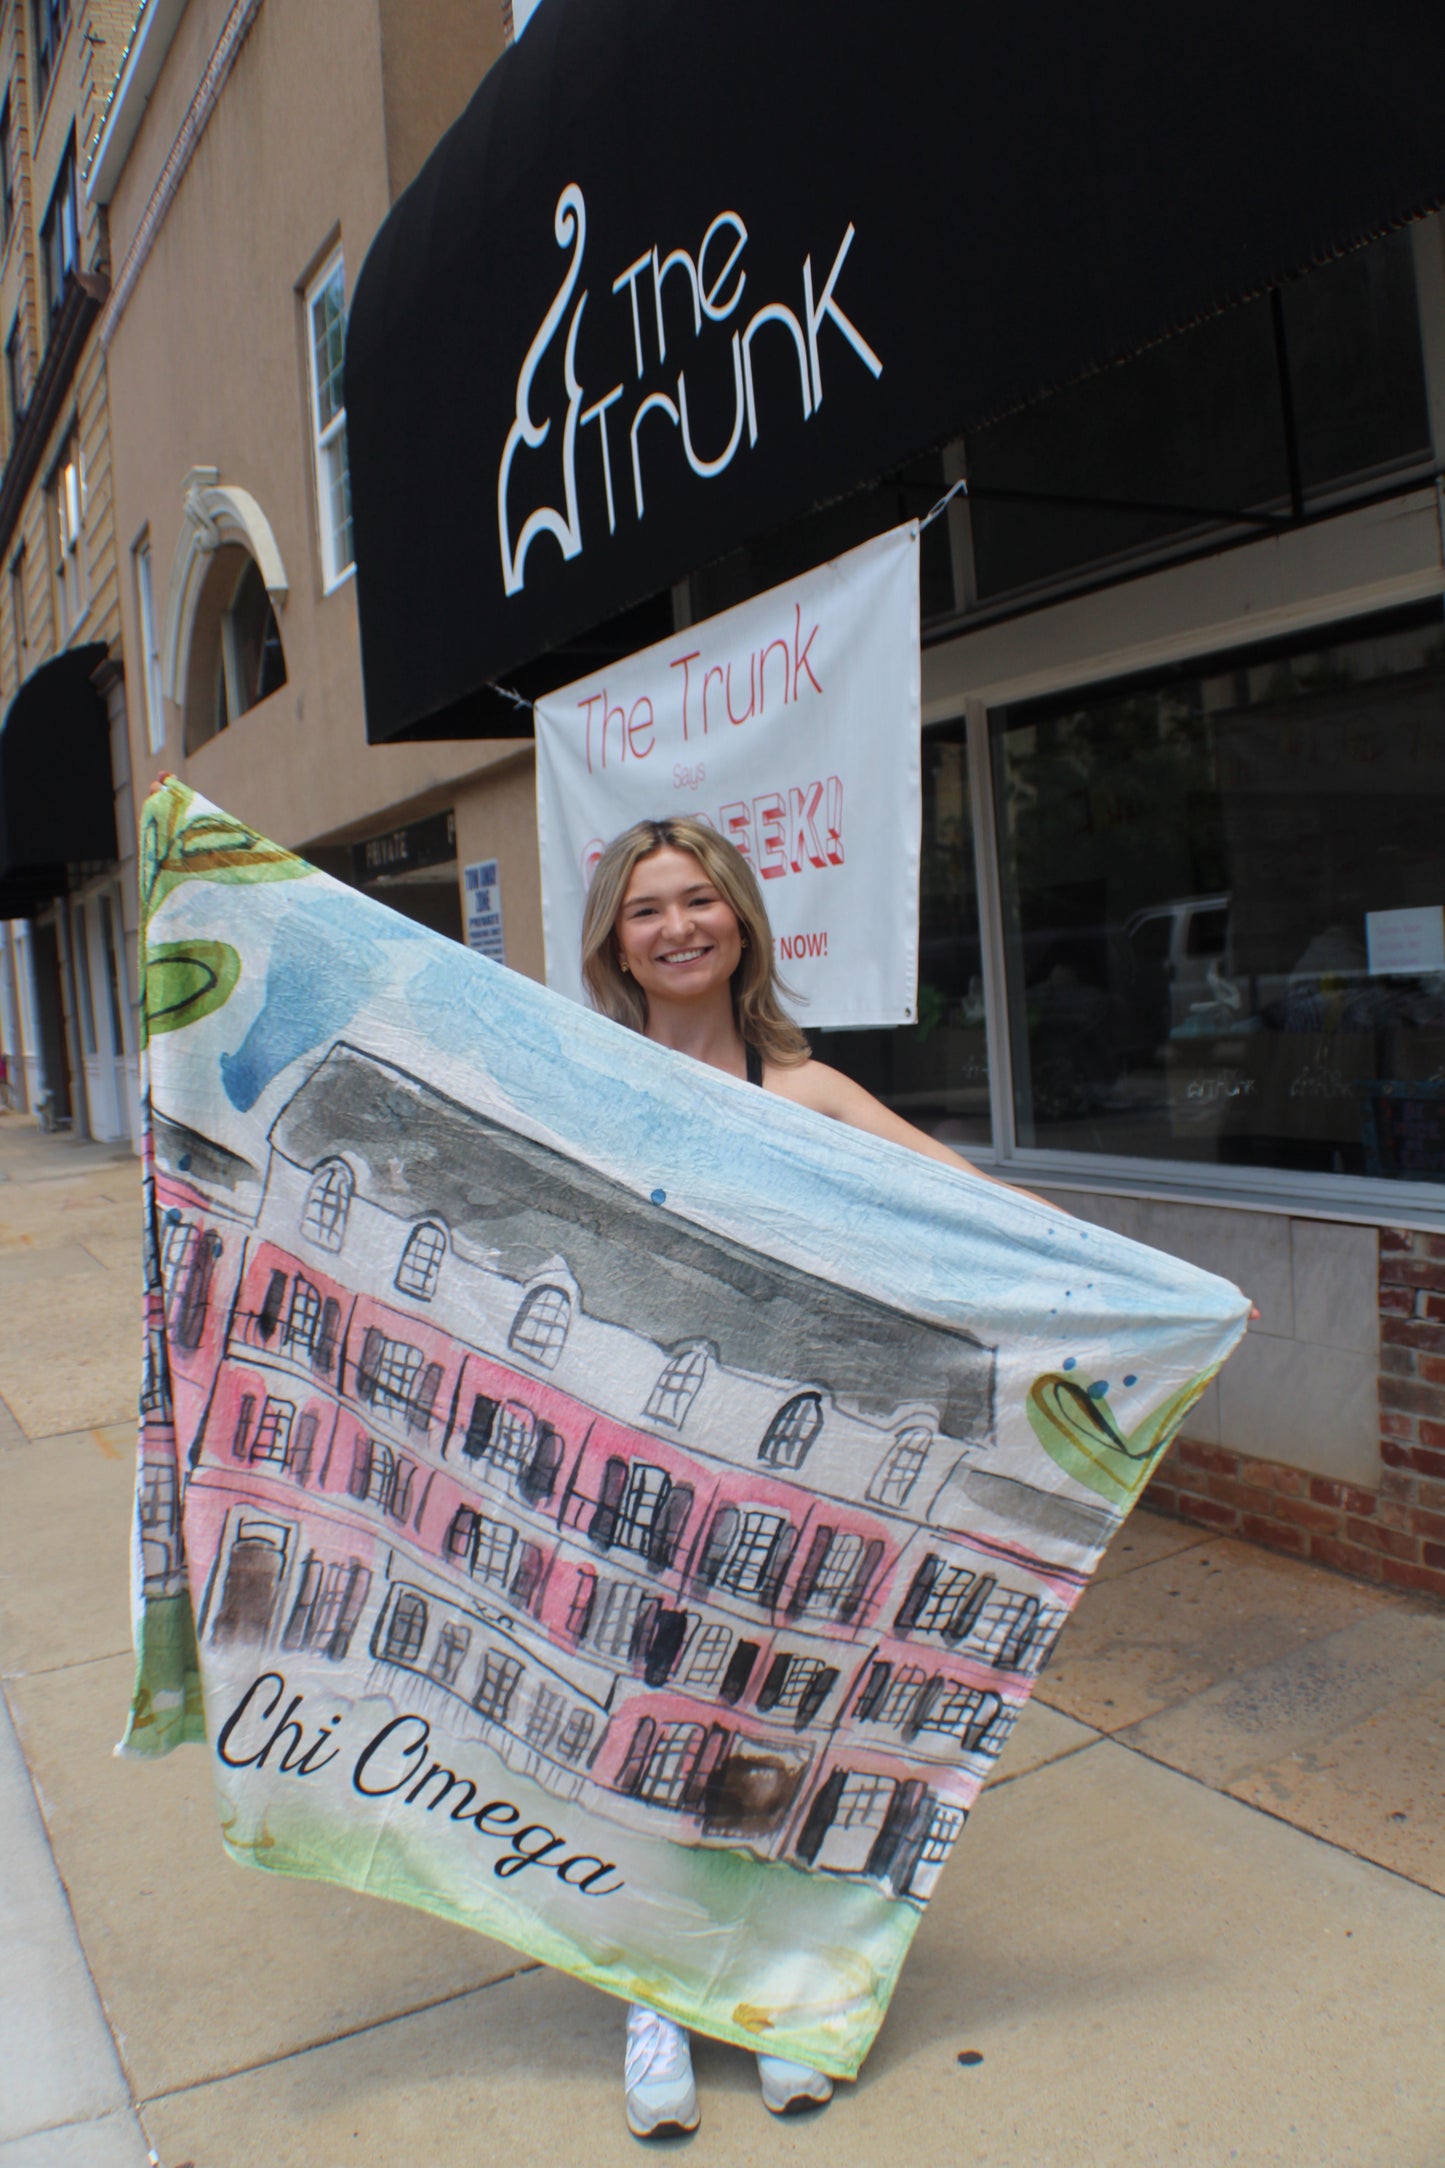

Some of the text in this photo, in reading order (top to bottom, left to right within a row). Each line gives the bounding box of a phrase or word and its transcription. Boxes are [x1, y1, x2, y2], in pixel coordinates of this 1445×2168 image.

[578, 603, 823, 775] The Trunk
[672, 761, 706, 791] Says
[780, 932, 828, 960] NOW!
[216, 1672, 625, 1895] Chi Omega
